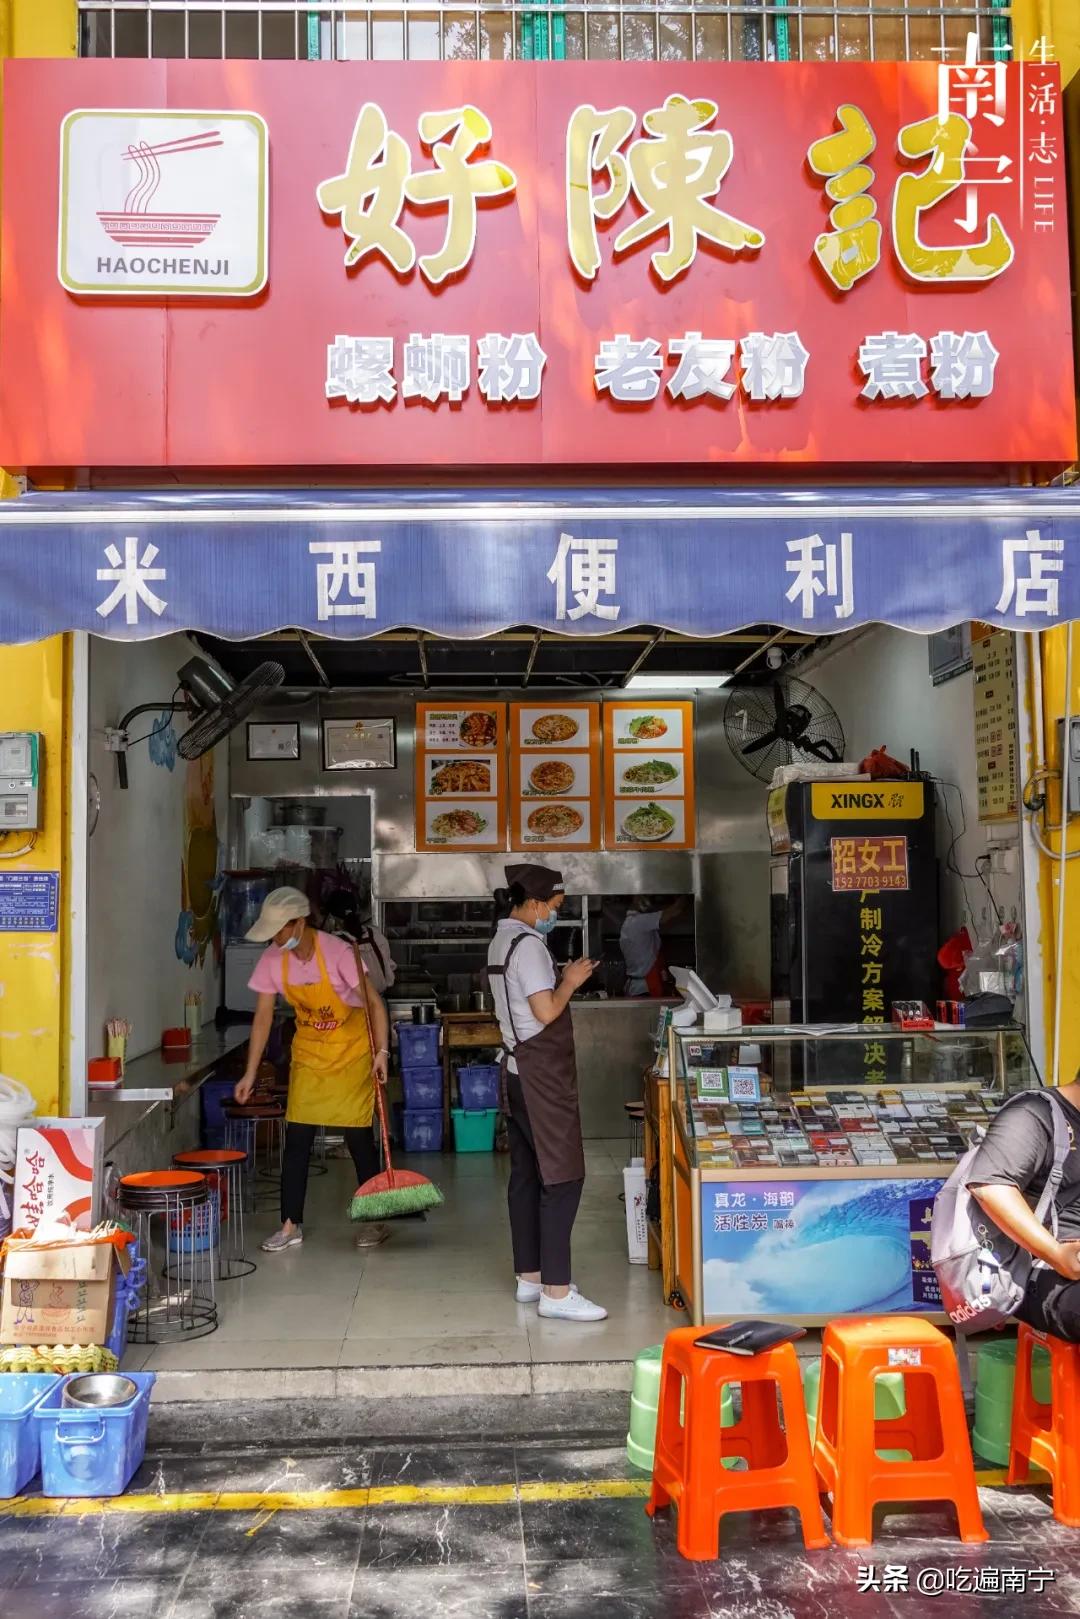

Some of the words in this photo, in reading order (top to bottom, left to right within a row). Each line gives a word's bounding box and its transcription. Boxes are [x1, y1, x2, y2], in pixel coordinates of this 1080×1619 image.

[316, 93, 1015, 291] 好陳記
[96, 256, 230, 277] HAOCHENJI
[325, 332, 547, 403] 螺蛳粉
[595, 331, 810, 401] 老友粉
[857, 330, 1001, 400] 煮粉
[95, 530, 1066, 625] 米西便利店
[831, 793, 885, 809] XINGX
[833, 839, 905, 874] 招女工
[835, 877, 853, 888] 152
[855, 876, 880, 888] 7703
[713, 1212, 769, 1233] 活性炭
[949, 1294, 992, 1324] adidas
